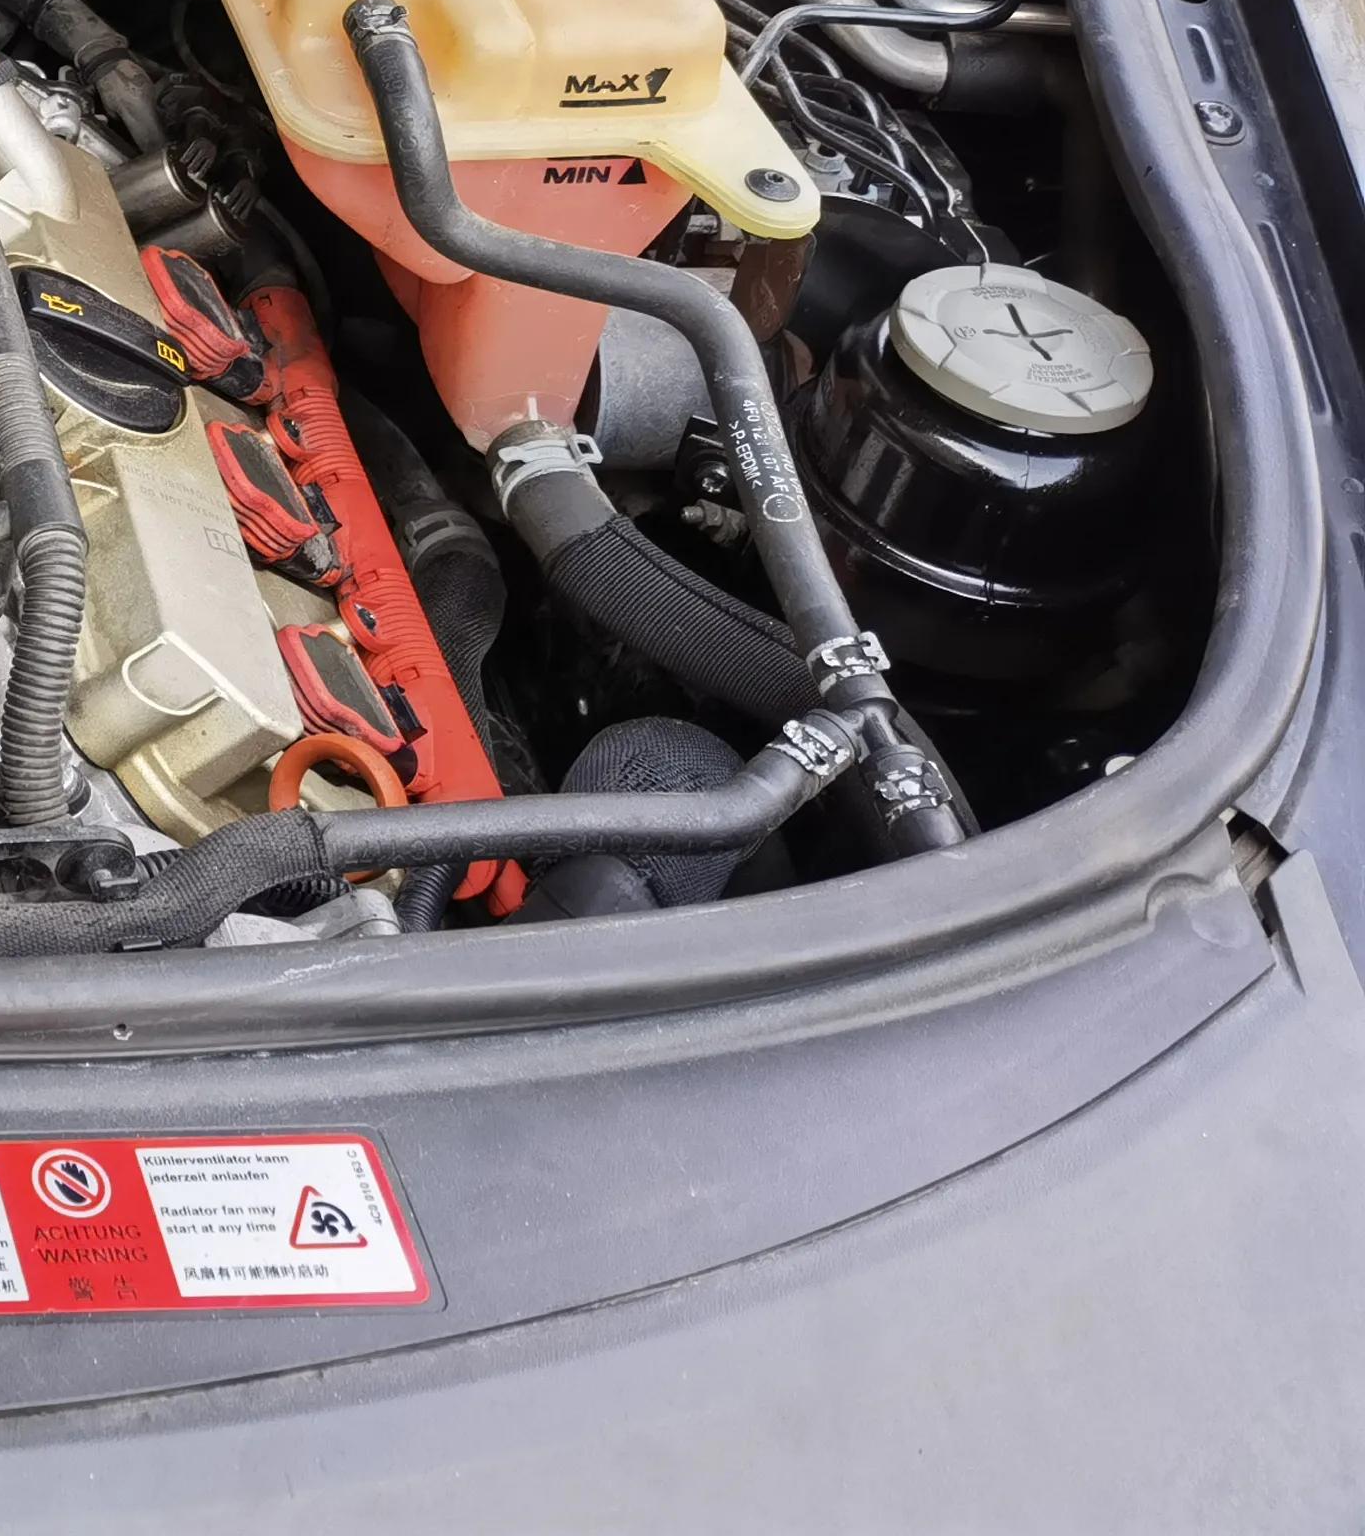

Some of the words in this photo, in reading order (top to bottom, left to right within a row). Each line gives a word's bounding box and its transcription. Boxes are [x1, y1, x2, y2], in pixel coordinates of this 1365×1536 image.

[565, 74, 640, 94] MAX
[543, 166, 611, 184] MIN
[742, 399, 761, 422] 4F0
[760, 453, 781, 472] 107
[770, 475, 789, 492] AF
[142, 1153, 252, 1167] Kühlerventilator
[256, 1154, 289, 1164] kann
[149, 1172, 207, 1185] jederzeit
[211, 1171, 270, 1182] anlaufen
[160, 1205, 219, 1218] Radiator
[222, 1205, 245, 1216] fan
[248, 1206, 277, 1218] may
[34, 1224, 142, 1241] ACHTUNG
[166, 1223, 198, 1235] start
[201, 1223, 215, 1234] at
[218, 1224, 243, 1236] any
[246, 1222, 277, 1233] time
[37, 1246, 148, 1264] WARNING
[183, 1264, 329, 1281] 风扇有可能随时启动
